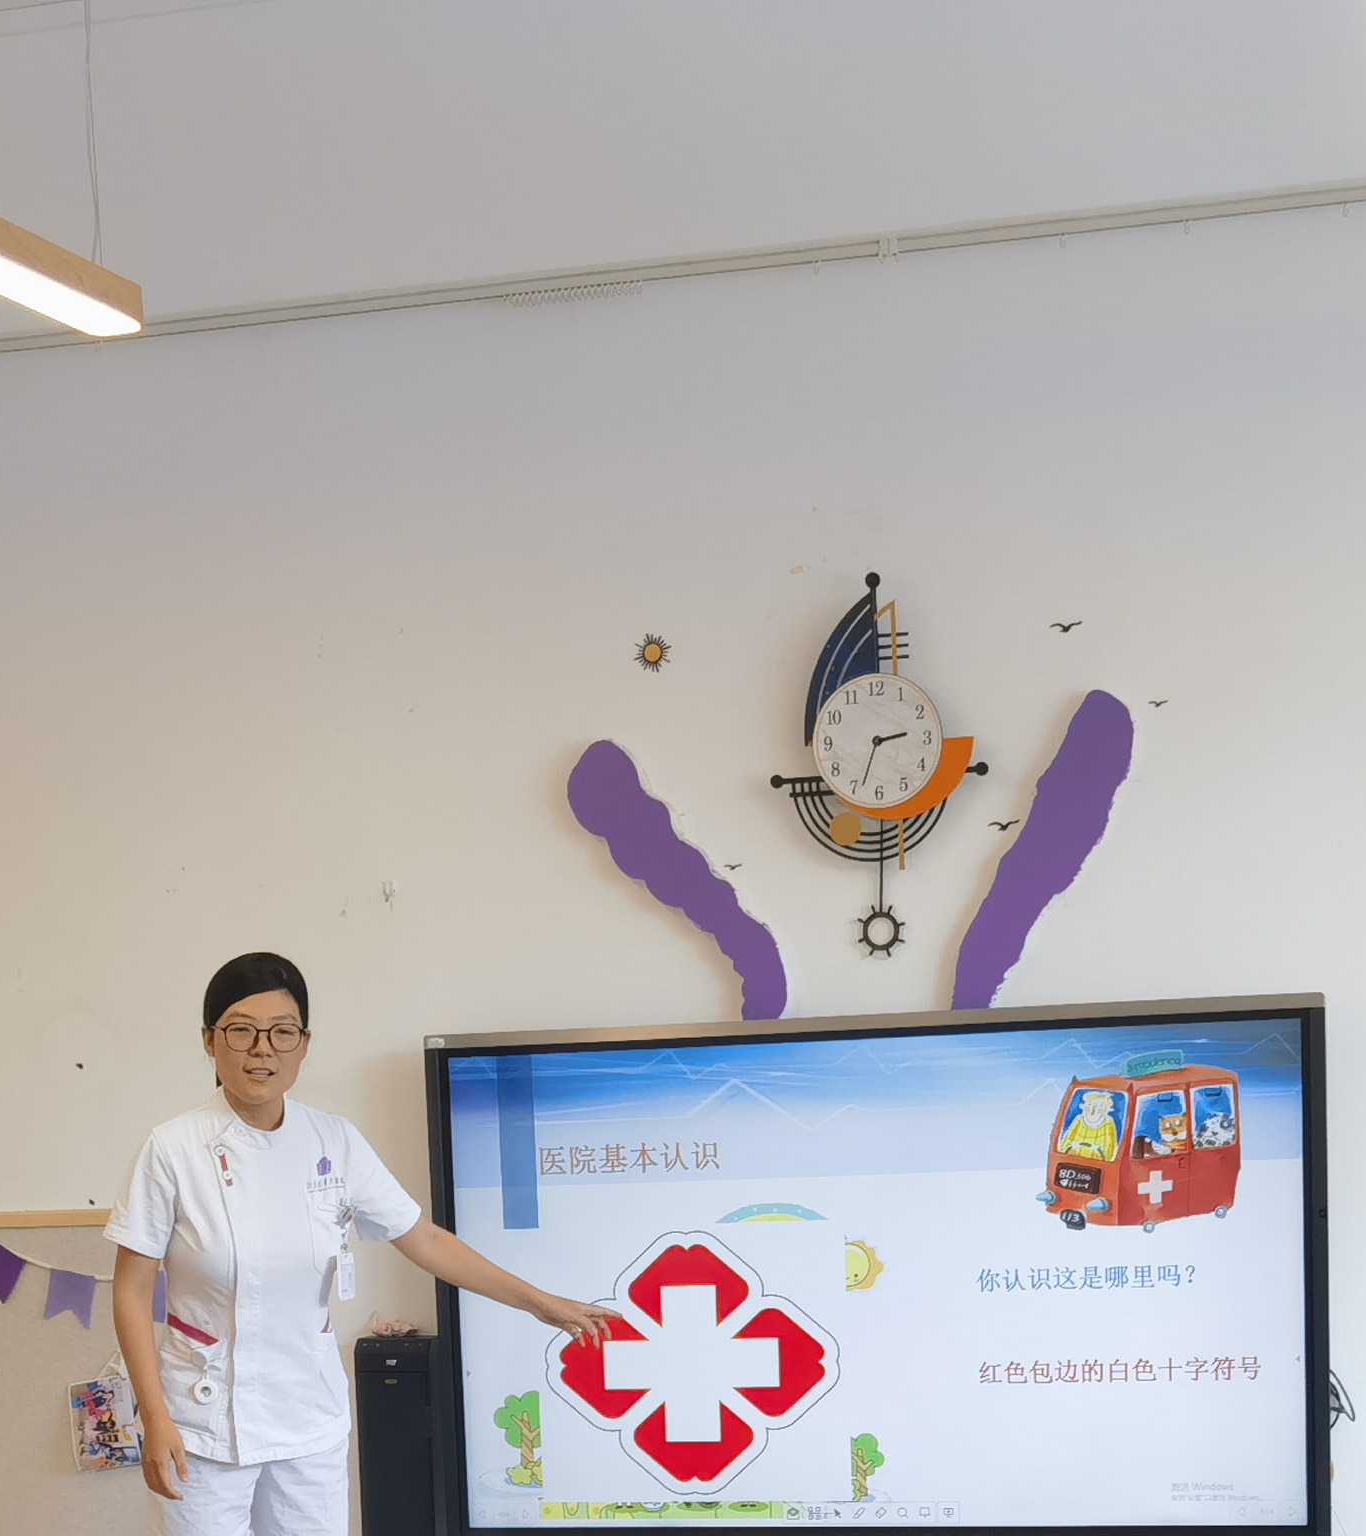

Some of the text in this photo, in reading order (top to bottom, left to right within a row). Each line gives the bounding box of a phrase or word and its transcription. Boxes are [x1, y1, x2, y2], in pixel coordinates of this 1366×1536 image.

[868, 681, 885, 696] 12
[898, 687, 904, 701] 1
[844, 690, 859, 705] 11
[827, 710, 842, 725] 10
[915, 704, 925, 719] 2
[823, 736, 833, 751] 9
[923, 730, 932, 745] 3
[831, 762, 840, 776] 8
[917, 757, 926, 771] 4
[850, 780, 858, 795] 7
[899, 777, 908, 791] 5
[875, 786, 883, 800] 6
[539, 1141, 720, 1176] 医院基本认识
[976, 1264, 1196, 1293] 你认识这是哪里吗？
[978, 1356, 1262, 1384] 红色包边的白色十字符号
